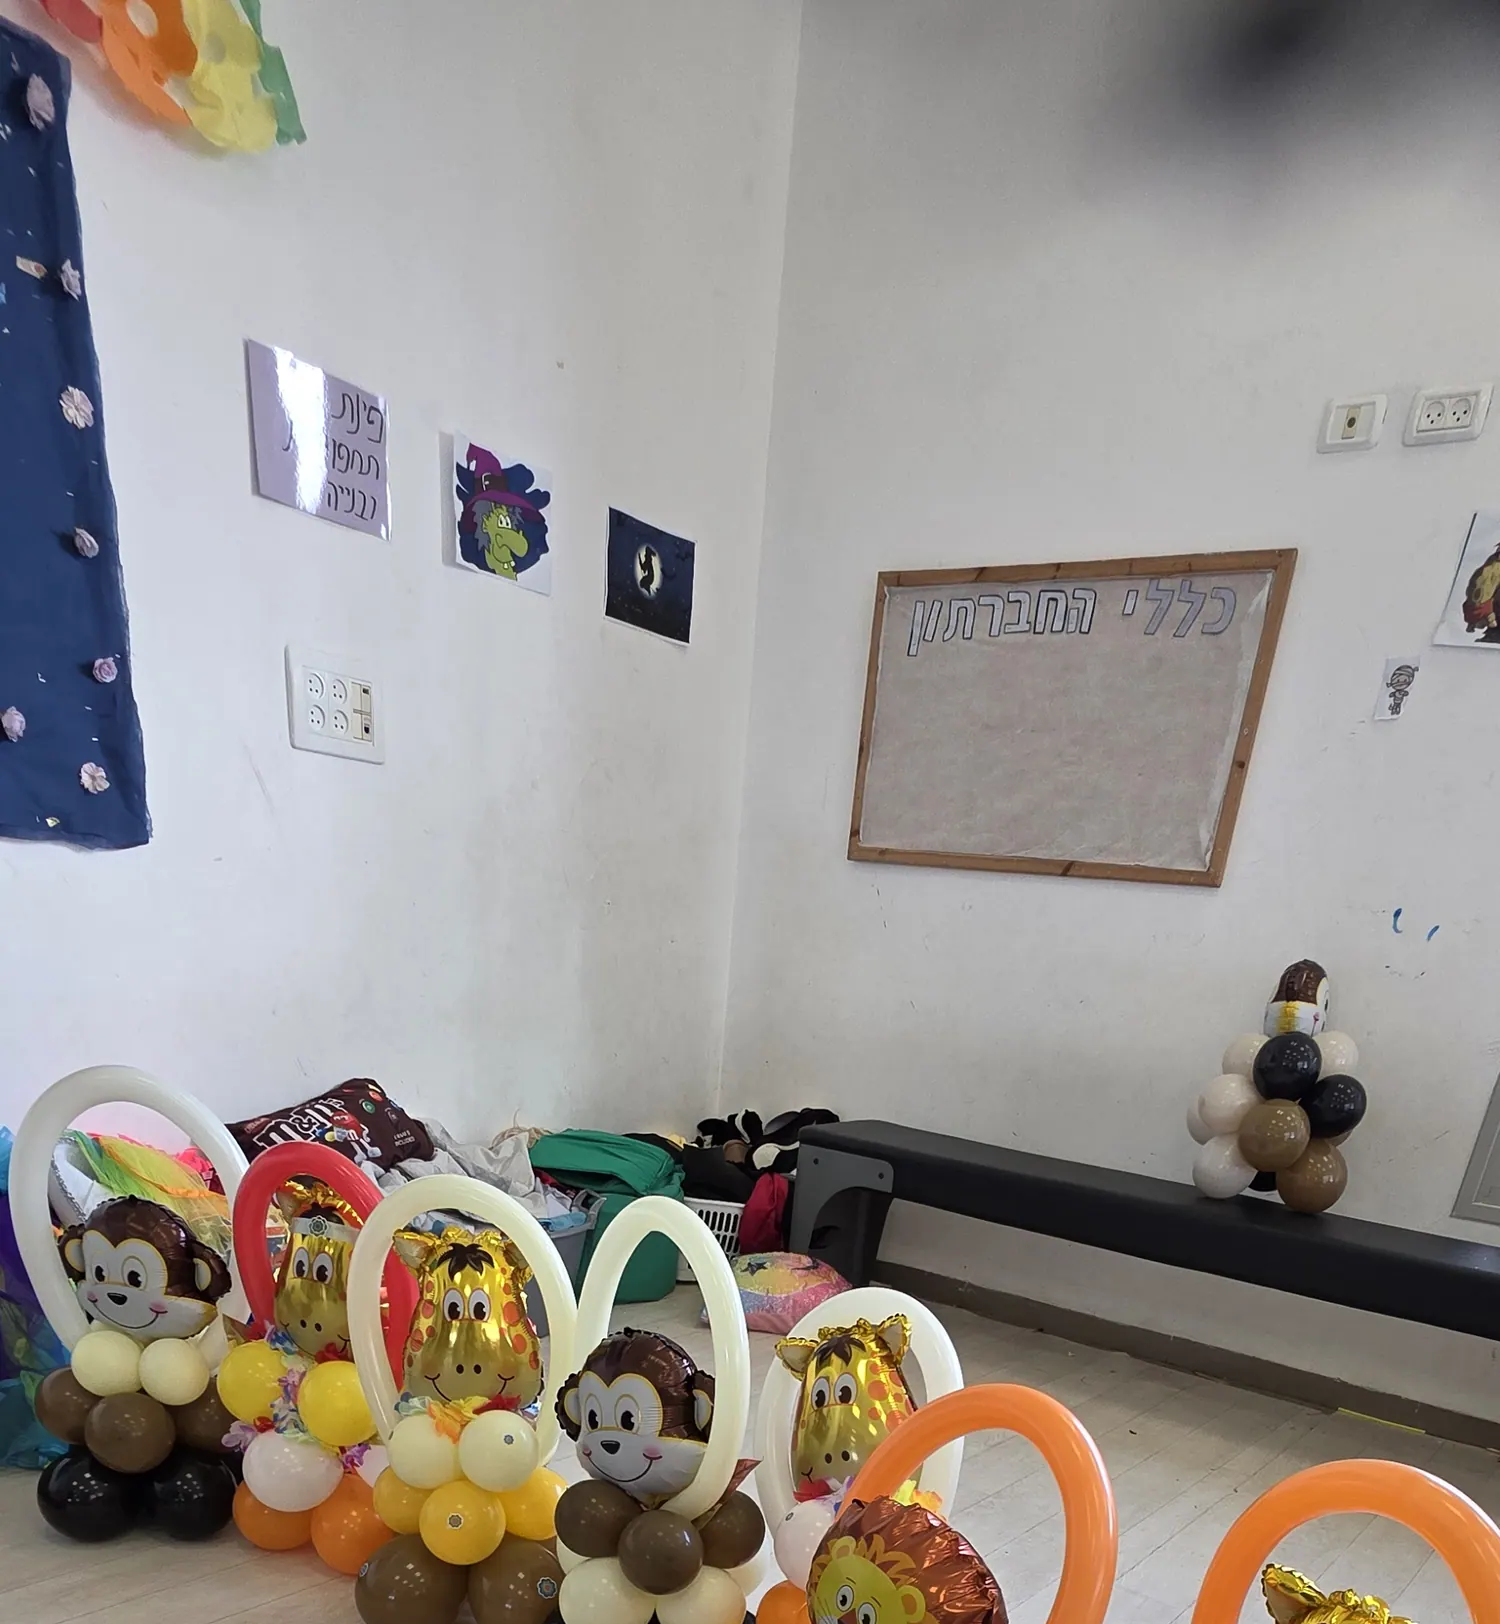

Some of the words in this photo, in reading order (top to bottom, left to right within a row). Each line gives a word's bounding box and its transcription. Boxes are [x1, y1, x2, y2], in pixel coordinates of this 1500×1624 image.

[331, 392, 384, 444] פינת
[327, 480, 377, 521] ובנייה
[906, 587, 1098, 657] החברתון
[1121, 578, 1237, 638] כללי
